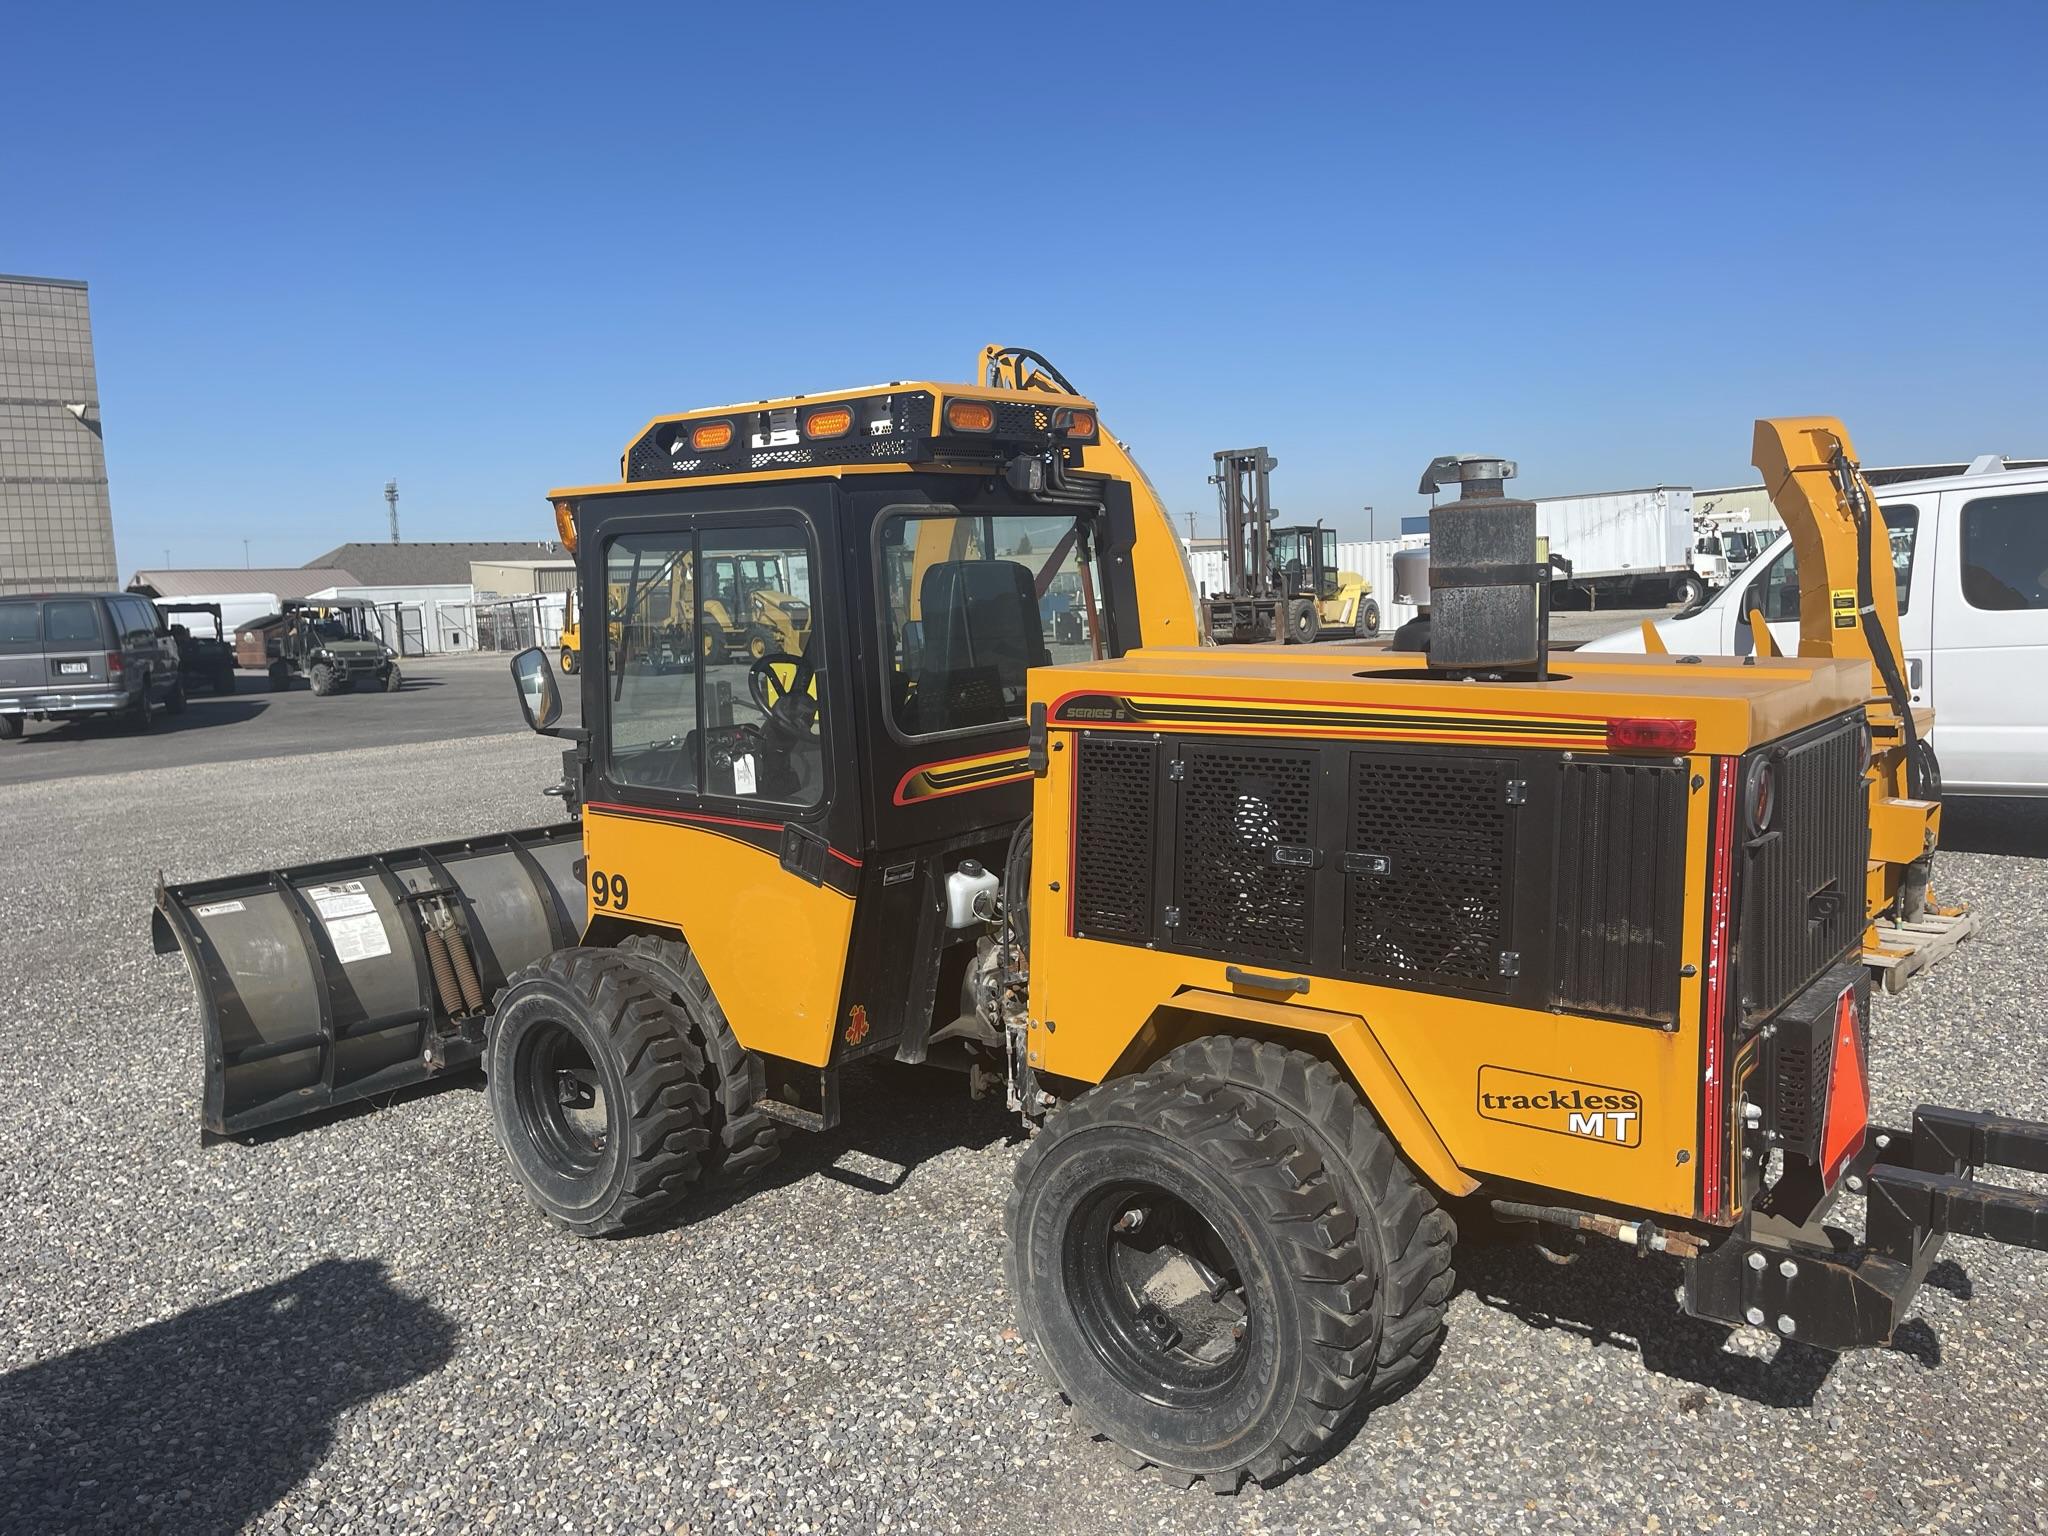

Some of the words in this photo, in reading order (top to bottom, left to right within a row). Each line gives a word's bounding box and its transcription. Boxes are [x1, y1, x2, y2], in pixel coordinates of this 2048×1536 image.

[1066, 707, 1113, 719] SERIES
[592, 870, 629, 910] 99
[1481, 1090, 1638, 1111] trackless
[1568, 1112, 1638, 1142] MT
